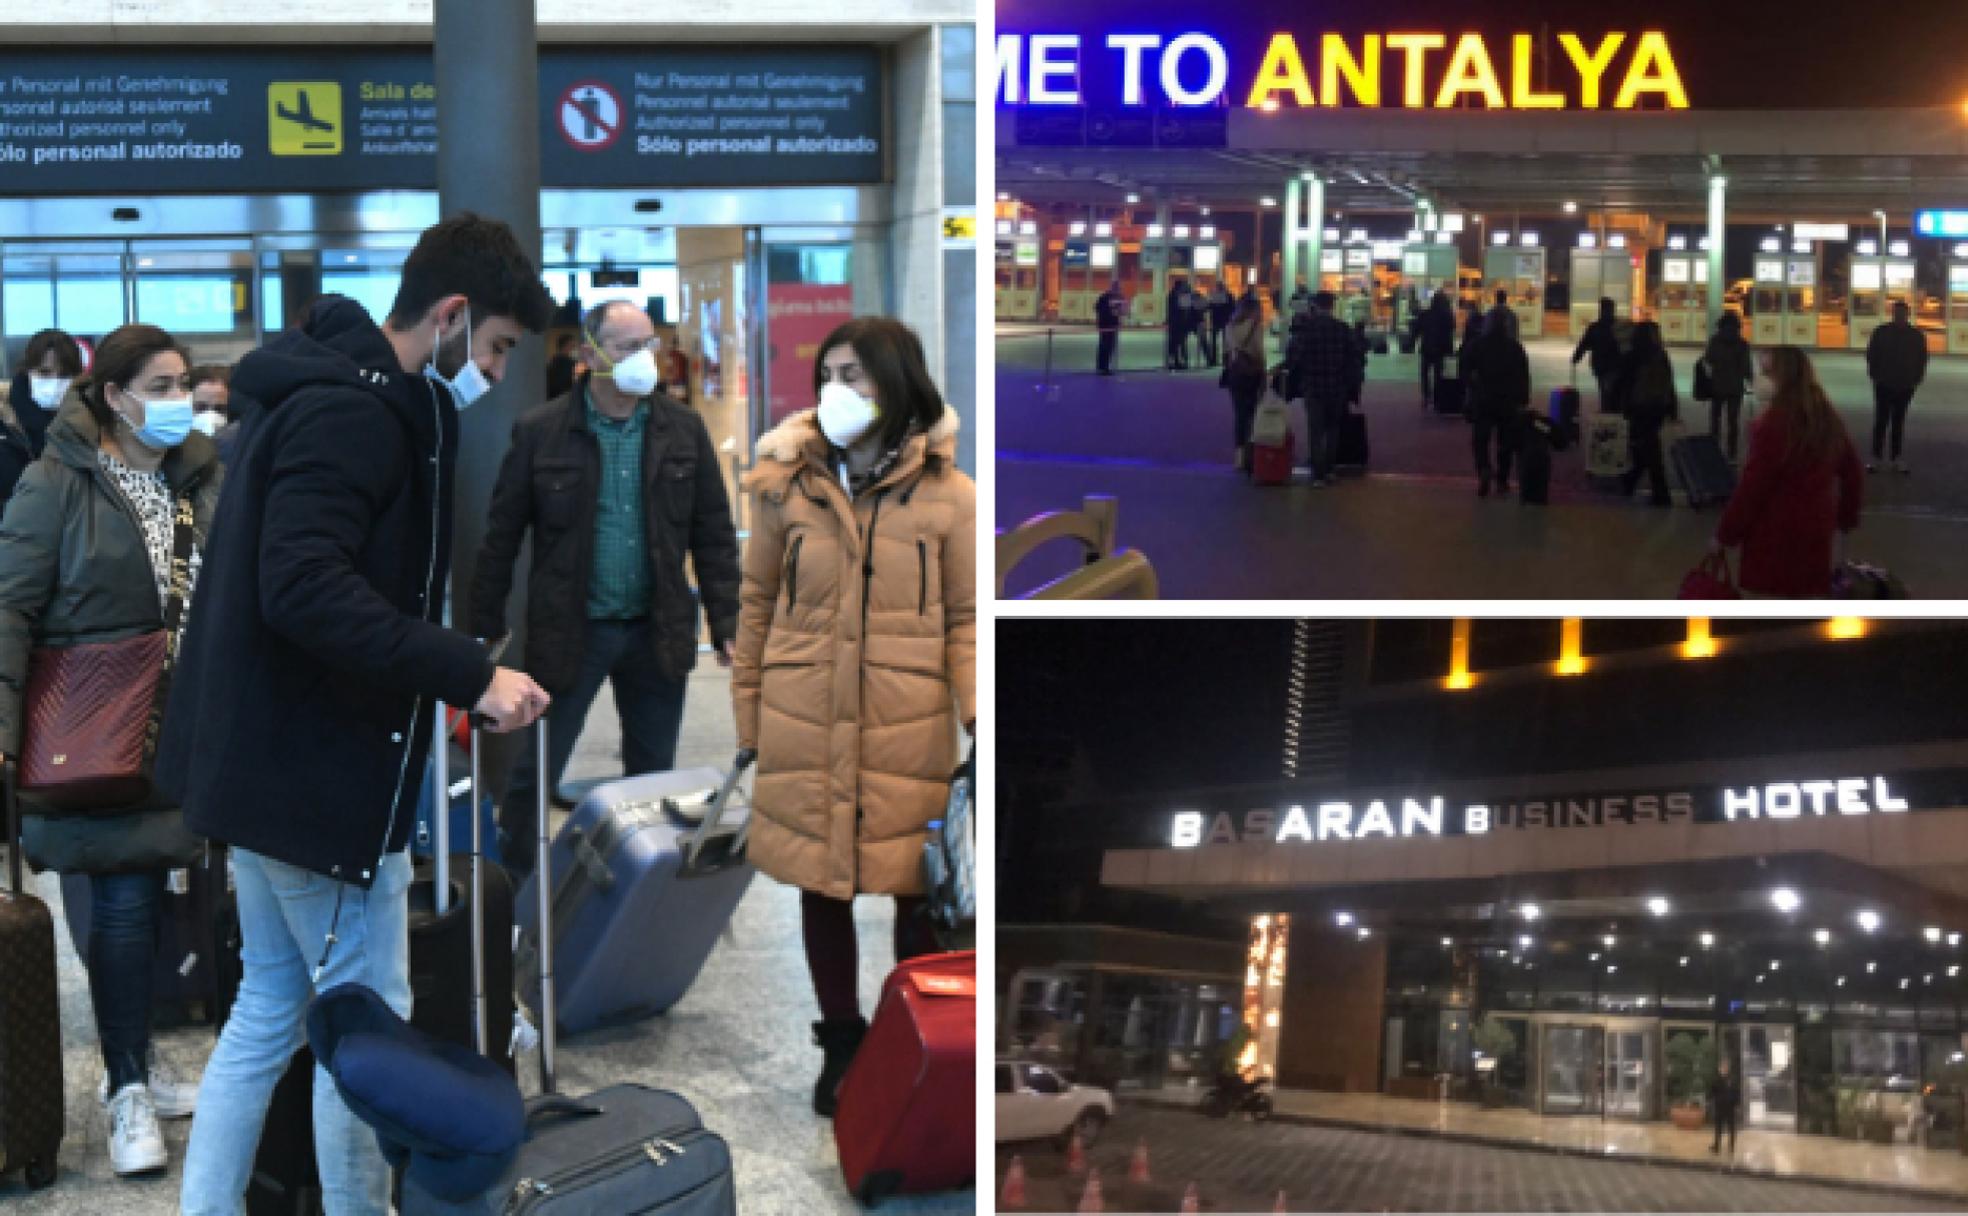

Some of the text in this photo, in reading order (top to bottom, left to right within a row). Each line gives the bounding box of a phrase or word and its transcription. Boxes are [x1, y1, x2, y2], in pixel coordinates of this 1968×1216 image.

[1106, 32, 1228, 105] TO
[1248, 31, 1690, 108] ANTALYA
[12, 76, 79, 94] Personal
[85, 76, 111, 93] mit
[117, 75, 229, 95] Genehmigung
[360, 81, 405, 99] Sala
[636, 73, 865, 92] Nur Personal mit Genehmigung
[129, 98, 212, 114] seulement
[69, 120, 146, 139] personnel
[151, 120, 186, 139] only
[637, 114, 825, 132] Authorized personnel only
[34, 141, 126, 165] personal
[132, 139, 243, 159] autorizado
[638, 134, 878, 158] Sólo personal autorizado
[1465, 792, 1691, 834] BUSINESS
[1723, 776, 1909, 820] HOTEL
